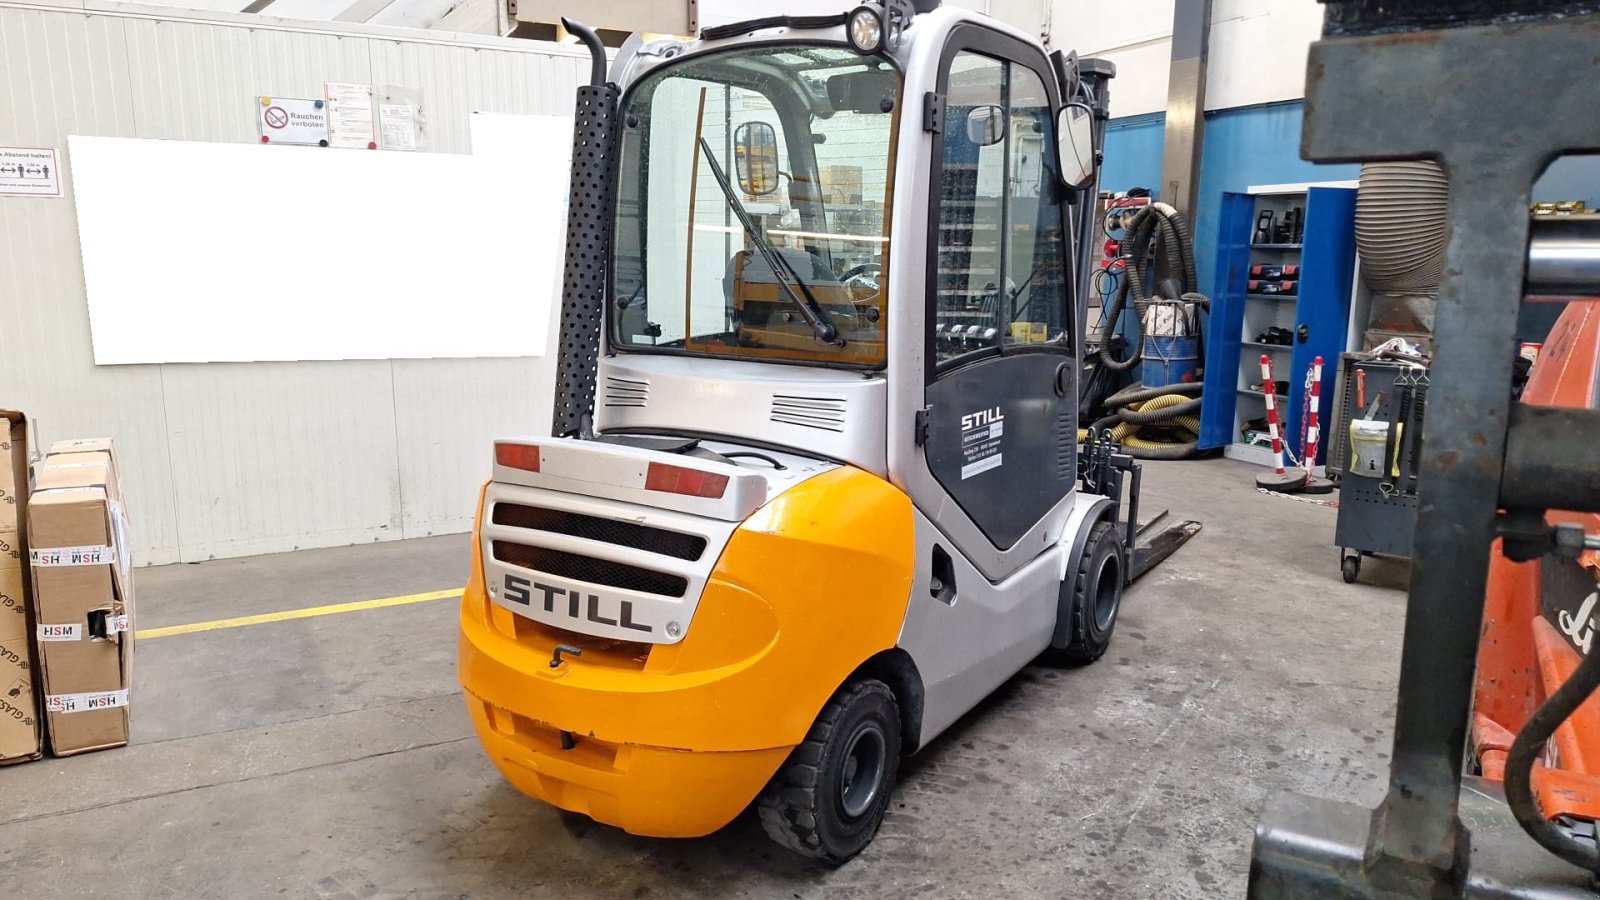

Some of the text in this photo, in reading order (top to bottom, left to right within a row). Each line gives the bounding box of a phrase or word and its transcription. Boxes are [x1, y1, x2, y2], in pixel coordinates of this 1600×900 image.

[290, 112, 324, 120] Rauchen
[291, 120, 325, 128] verboten
[962, 406, 1004, 431] STILL
[71, 553, 100, 564] HSM
[504, 573, 653, 633] STILL
[44, 626, 73, 636] HSM
[88, 696, 116, 709] HSM
